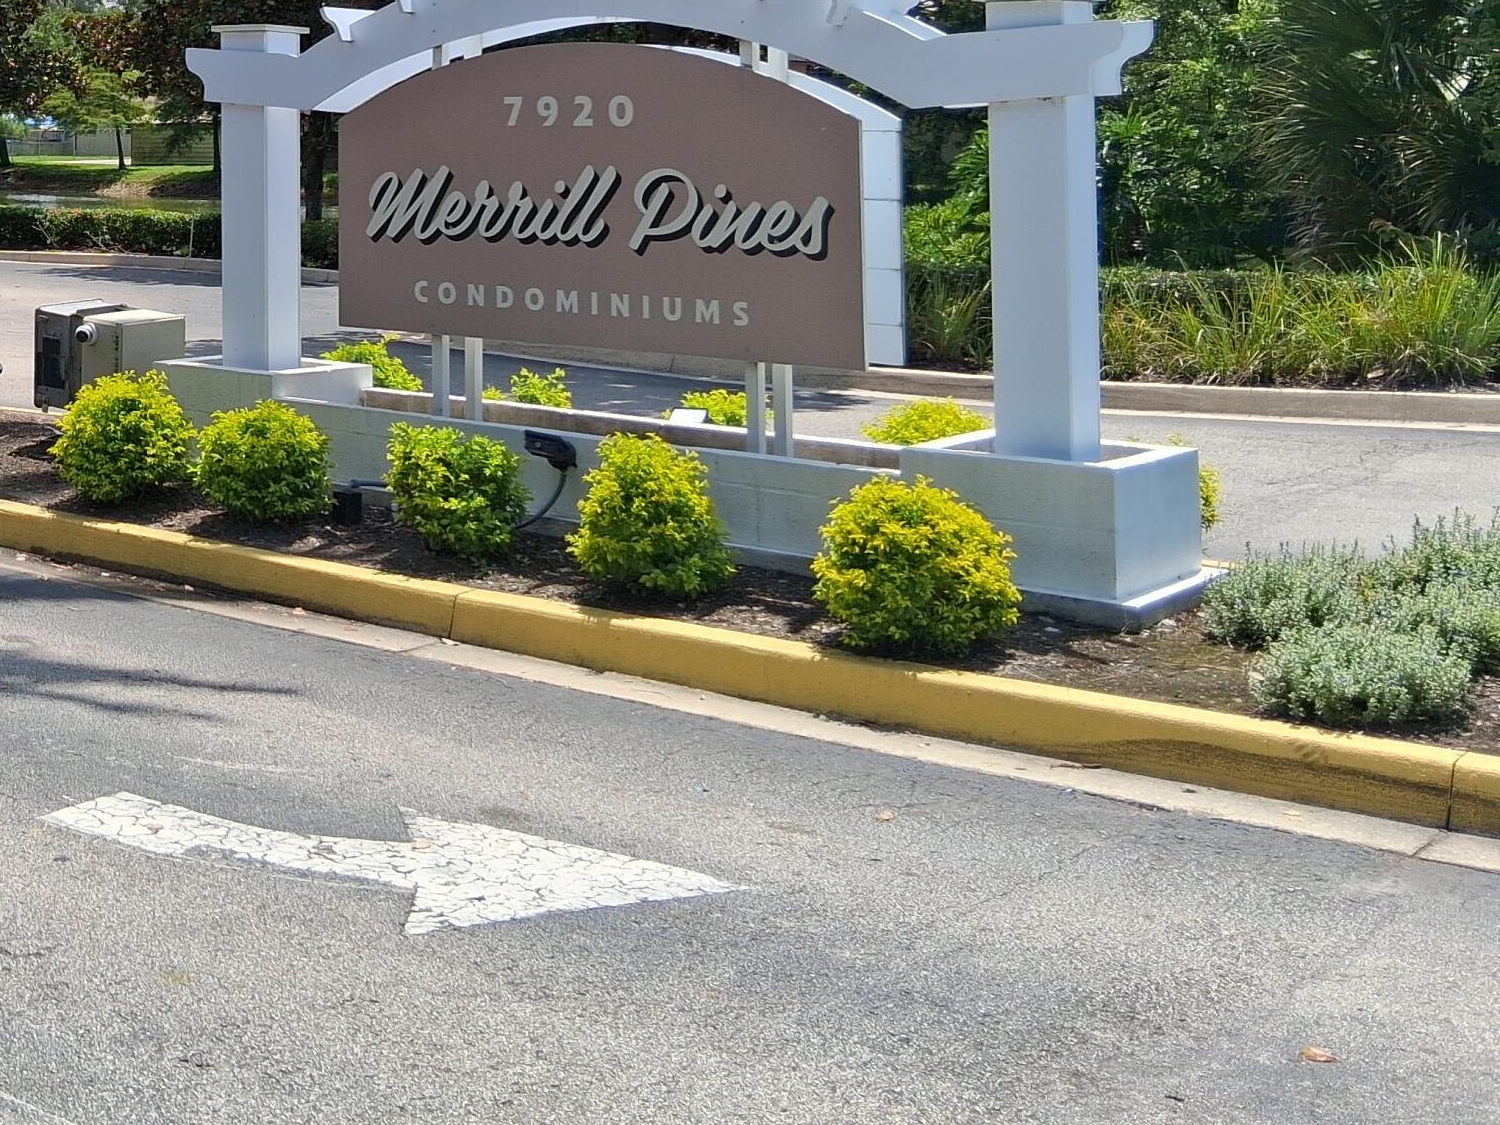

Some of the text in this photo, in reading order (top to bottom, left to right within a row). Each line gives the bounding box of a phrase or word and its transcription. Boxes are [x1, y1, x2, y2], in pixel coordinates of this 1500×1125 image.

[502, 94, 635, 128] 7920
[365, 164, 833, 259] Merrill Pines
[413, 280, 750, 327] CONDOMINIUMS
